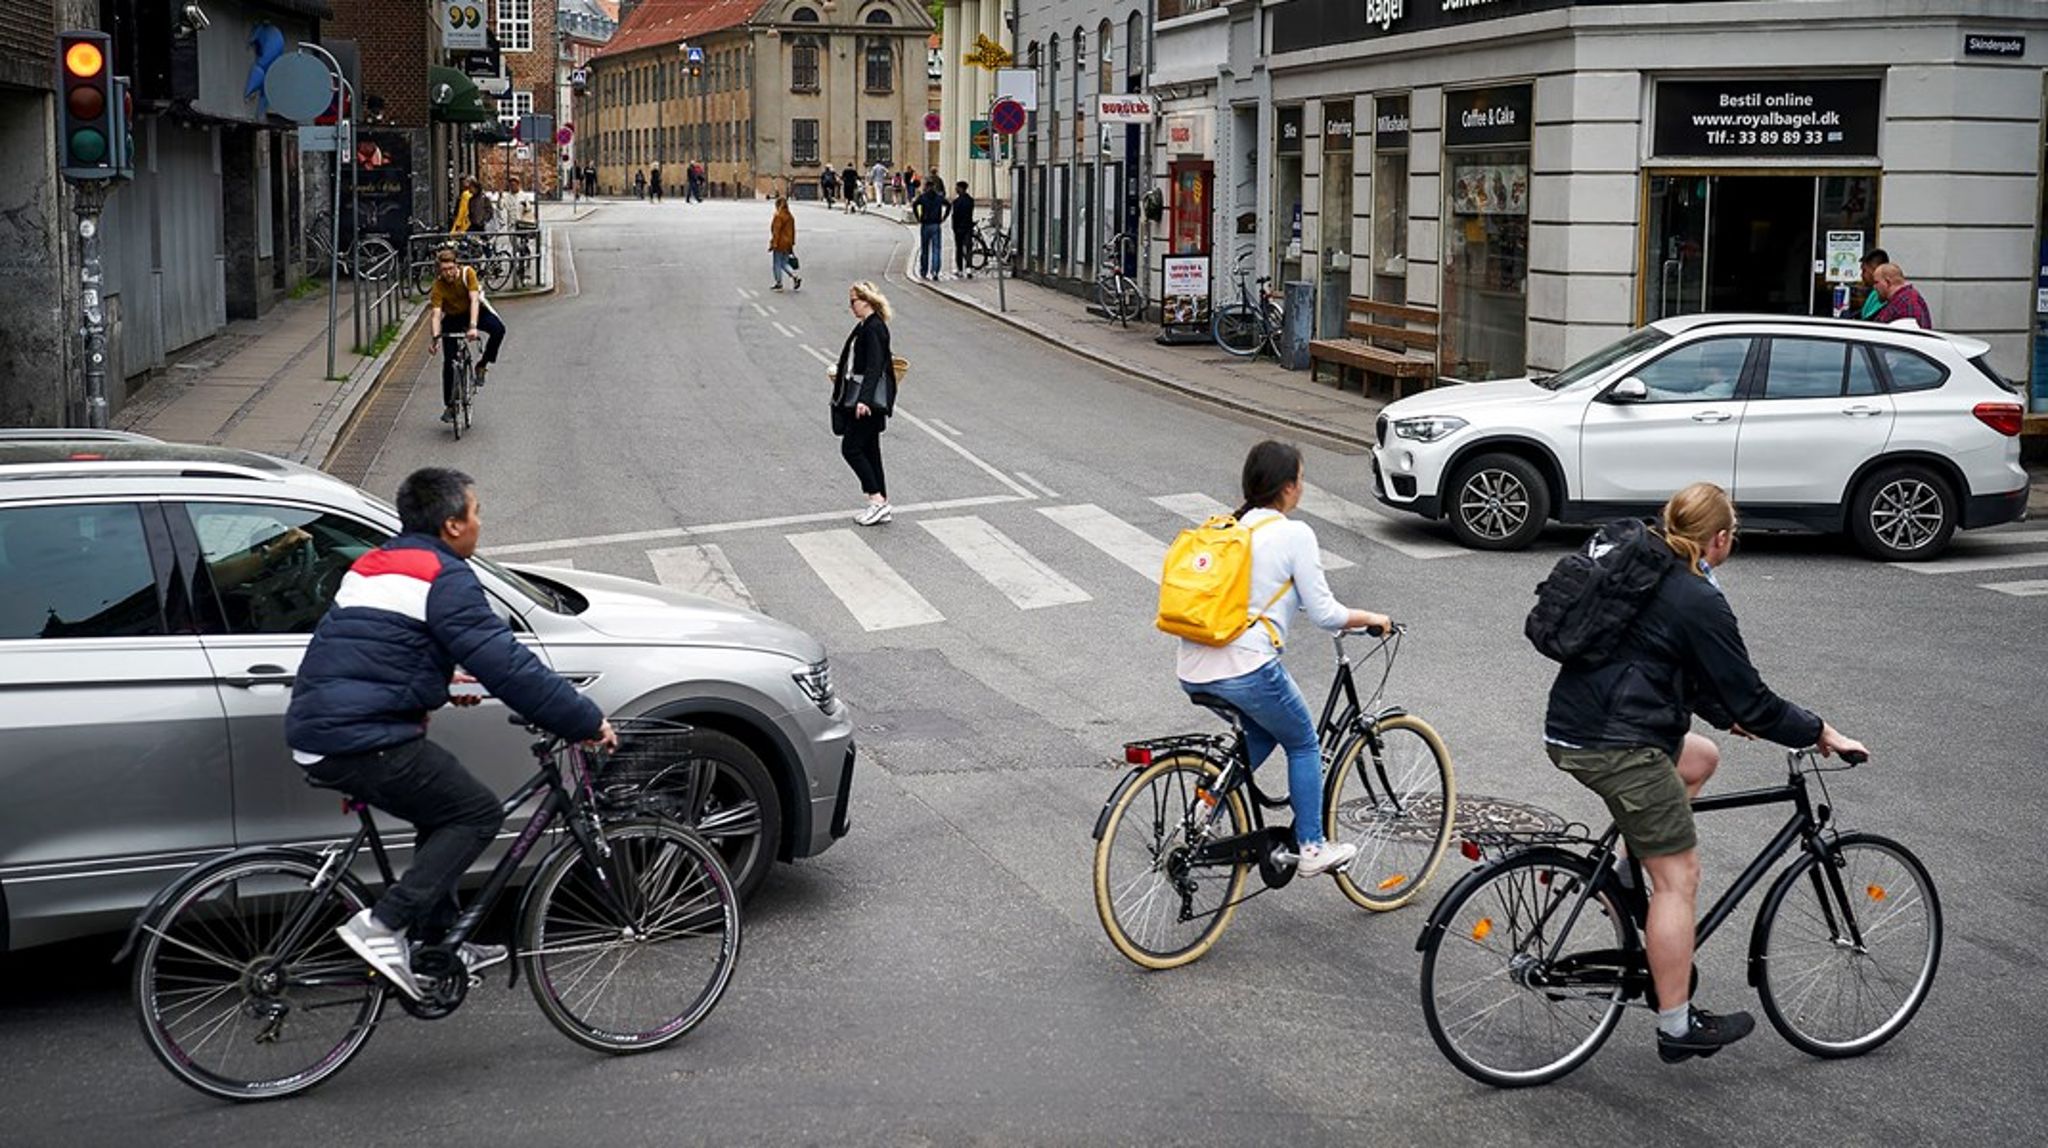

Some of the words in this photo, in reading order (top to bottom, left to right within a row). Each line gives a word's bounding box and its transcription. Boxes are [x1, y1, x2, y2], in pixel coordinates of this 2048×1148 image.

[1366, 0, 1403, 30] Bagel
[1969, 38, 2021, 52] Skindergade
[1102, 102, 1150, 114] BURGERS
[1720, 94, 1761, 107] Bestil
[1765, 94, 1813, 107] online
[1462, 108, 1486, 127] Coffee
[1488, 108, 1495, 125] &
[1496, 105, 1515, 126] Cake
[1692, 111, 1840, 128] www.royalbagel.dk
[1327, 118, 1352, 138] Catering
[1707, 131, 1735, 144] Tlf.:
[1738, 131, 1756, 144] 33
[1760, 131, 1779, 144] 89
[1782, 131, 1801, 144] 89
[1804, 131, 1823, 144] 33
